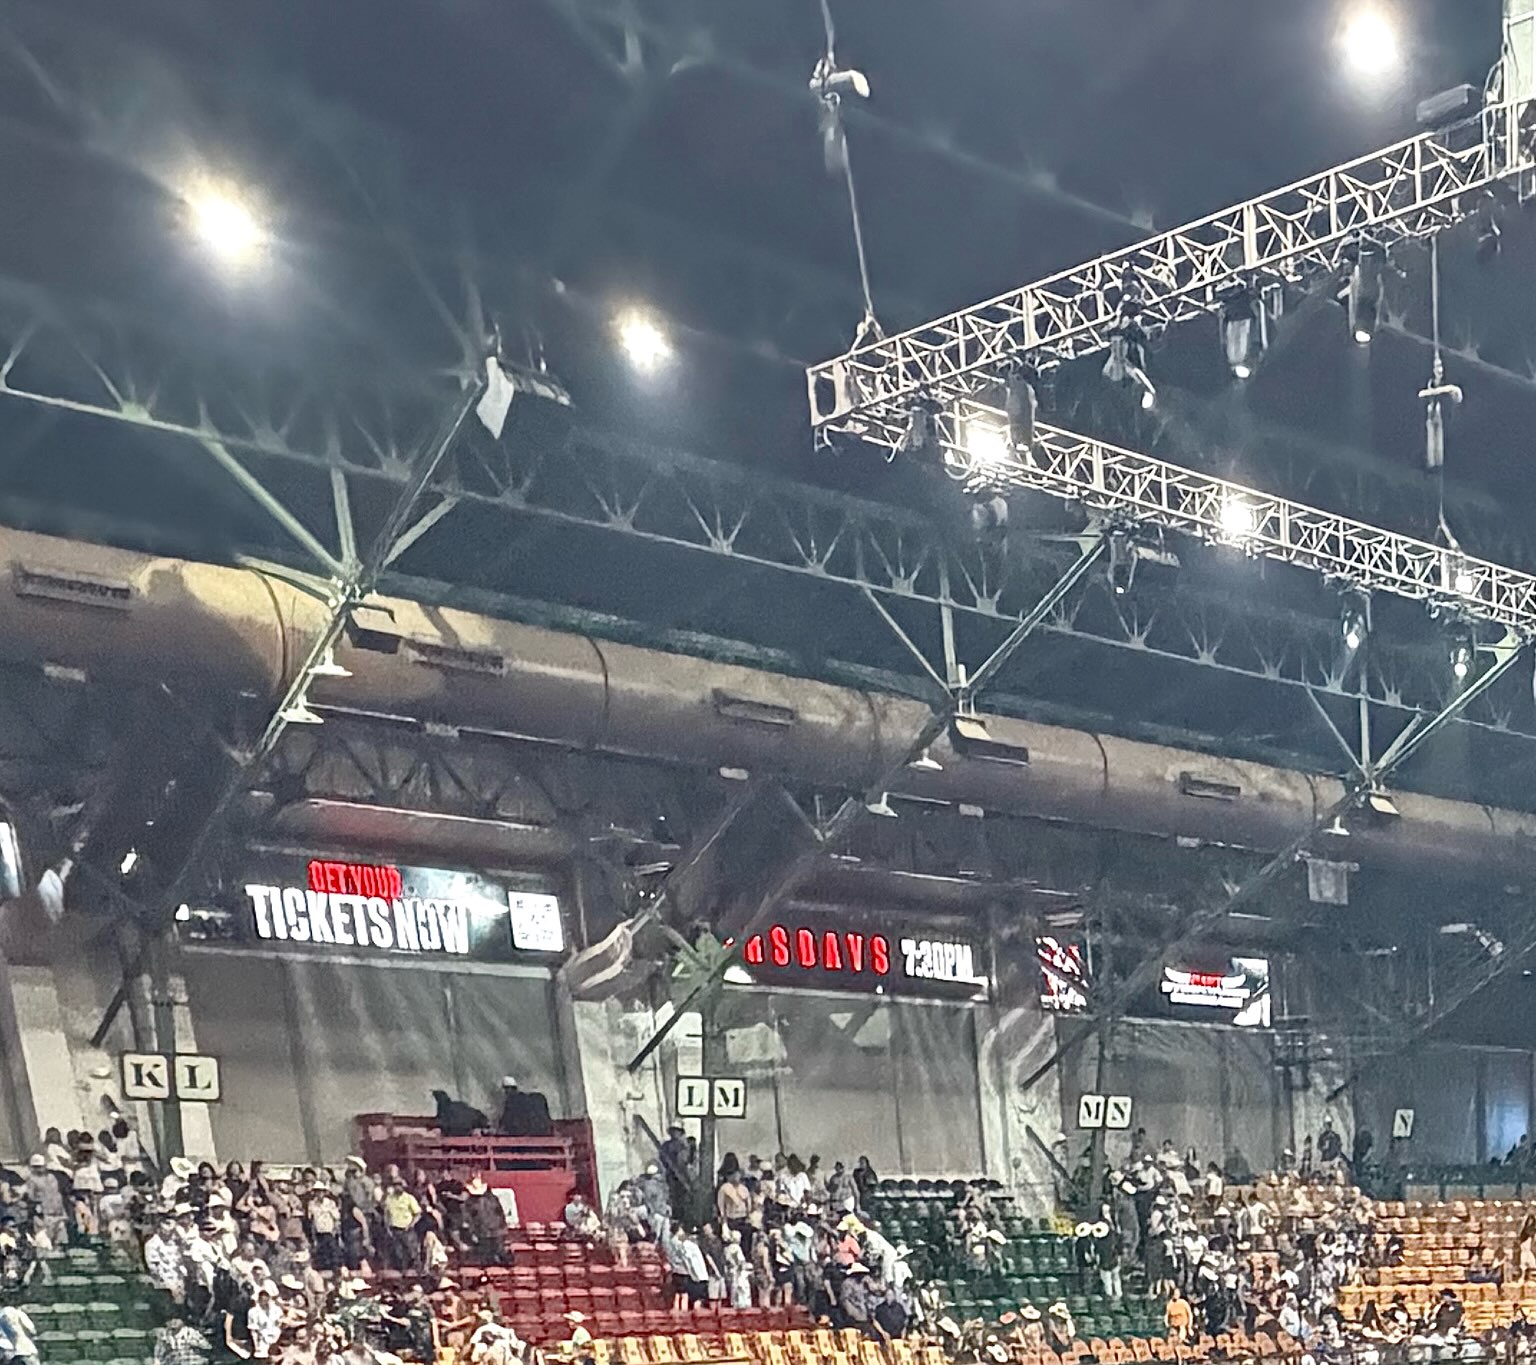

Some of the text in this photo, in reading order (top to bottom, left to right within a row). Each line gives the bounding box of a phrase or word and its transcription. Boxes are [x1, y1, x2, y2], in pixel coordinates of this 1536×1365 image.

[245, 885, 468, 954] TICKETS NOW
[131, 1062, 212, 1089] K L
[684, 1086, 740, 1107] L M
